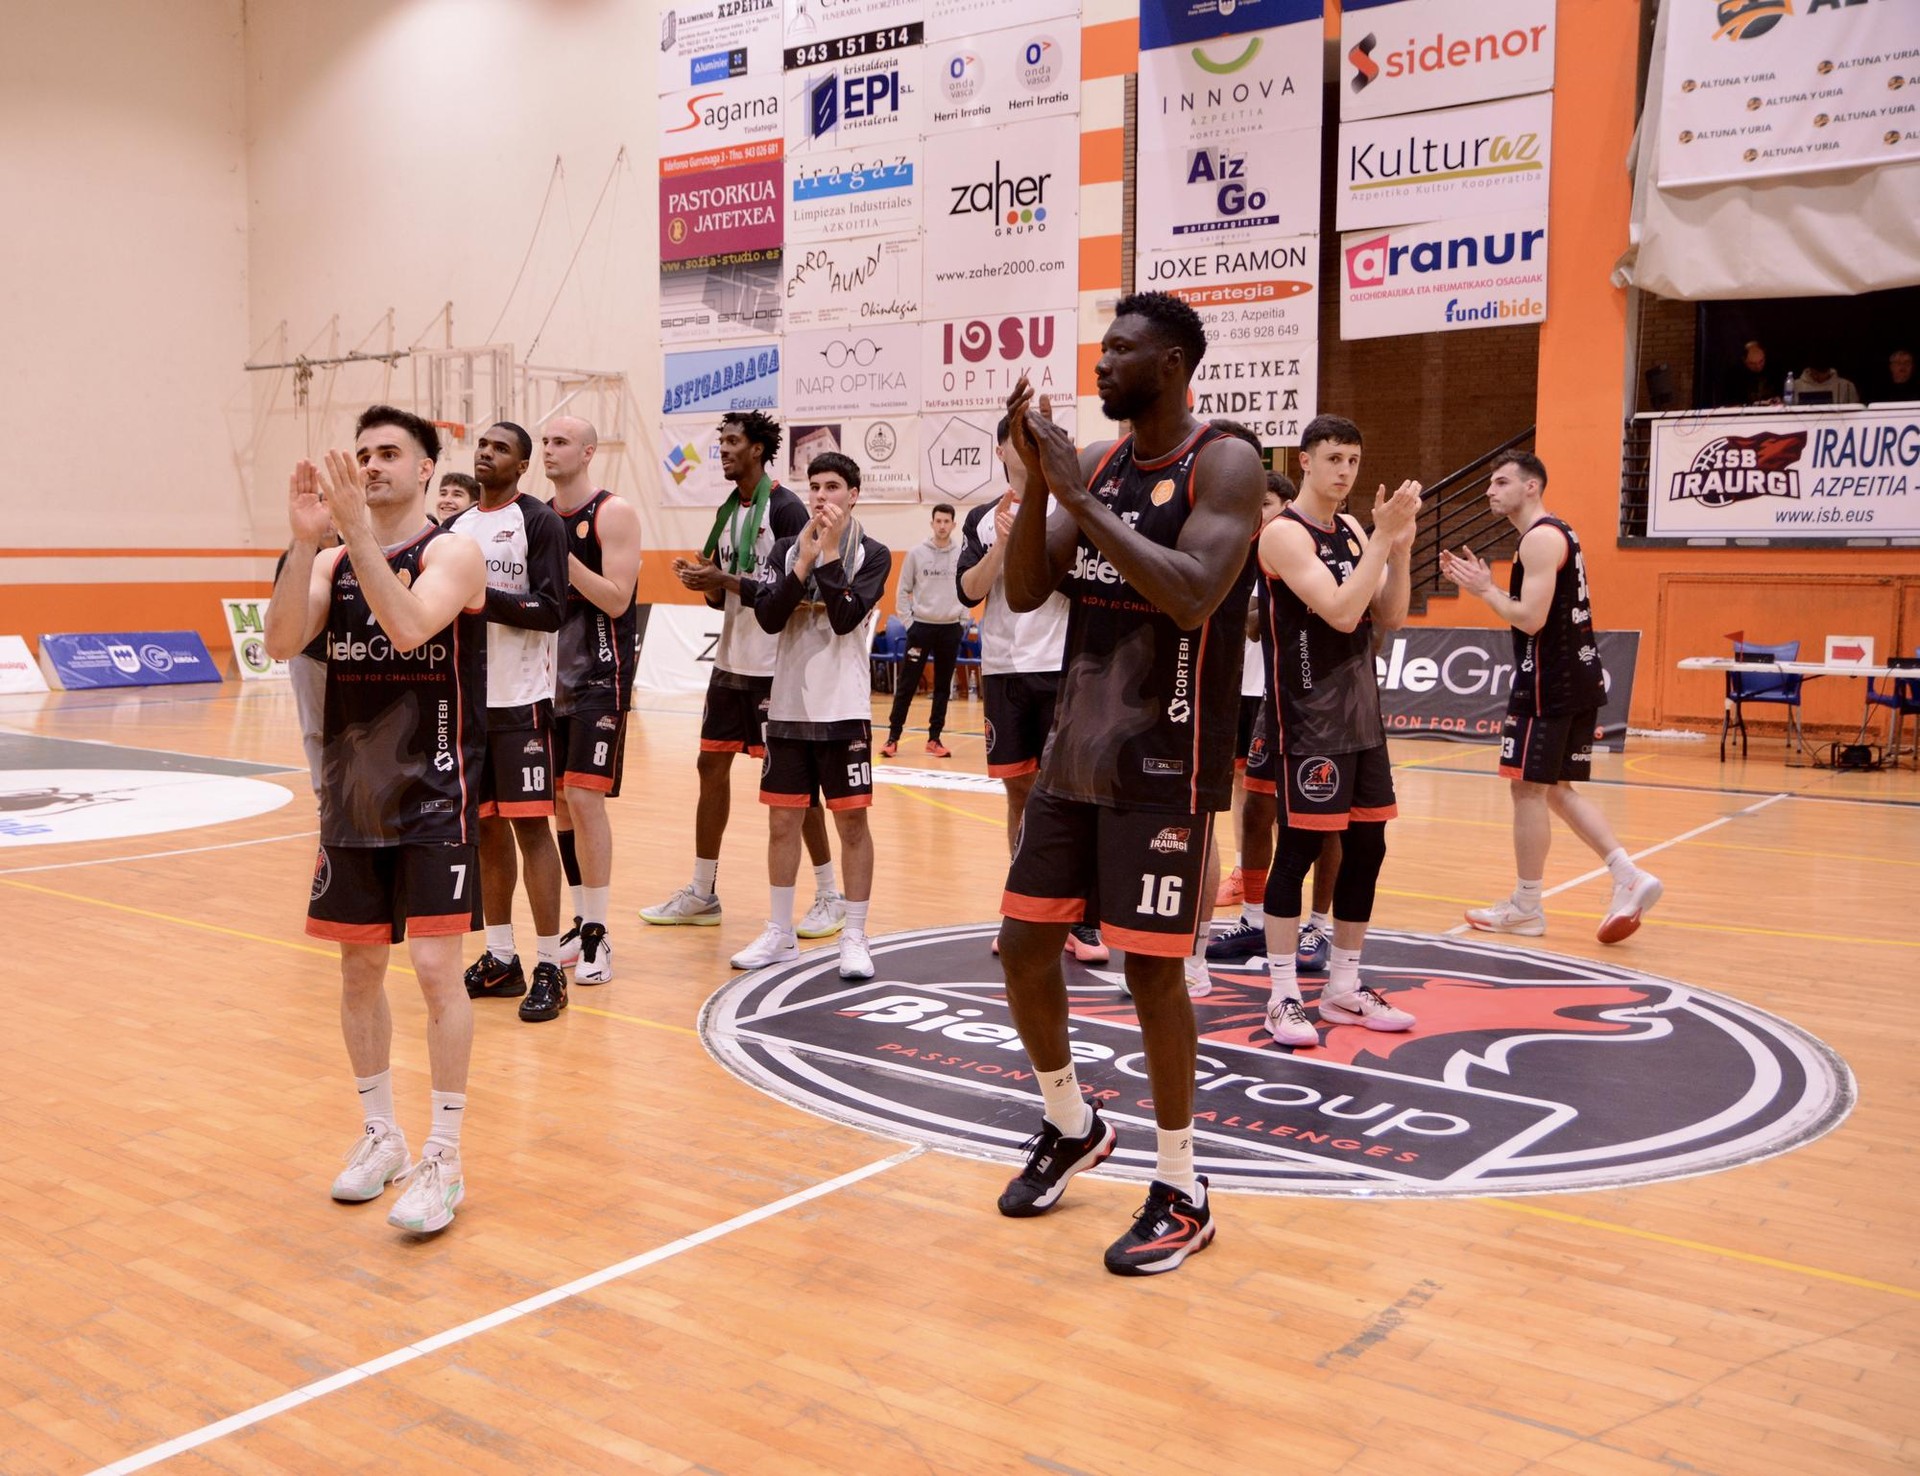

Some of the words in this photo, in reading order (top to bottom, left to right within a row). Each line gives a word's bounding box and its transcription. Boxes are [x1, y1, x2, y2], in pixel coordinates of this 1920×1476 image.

[797, 44, 828, 65] 943
[837, 36, 865, 57] 151
[876, 27, 909, 49] 514
[1385, 24, 1547, 77] sidenor
[844, 57, 898, 76] kristaldegia
[1838, 55, 1881, 70] ALTUNA
[1884, 54, 1891, 62] Y
[1893, 48, 1920, 61] URIA
[1025, 65, 1051, 77] onda
[1027, 75, 1051, 86] vasca
[1700, 77, 1741, 89] ALTUNA
[1743, 75, 1750, 84] Y
[1751, 72, 1776, 83] URIA
[844, 71, 899, 119] EPI
[949, 78, 974, 90] onda
[951, 88, 974, 99] vasca
[1163, 76, 1295, 114] INNOVA
[1009, 98, 1034, 110] Herri
[1037, 91, 1069, 105] Irratia
[1765, 94, 1807, 107] ALTUNA
[1809, 92, 1817, 101] Y
[1818, 88, 1844, 99] URIA
[665, 92, 778, 133] Sagarna
[934, 110, 958, 122] Herri
[961, 104, 991, 118] Irratia
[1191, 108, 1264, 126] AZPEITIA
[1833, 110, 1876, 123] ALTUNA
[1880, 108, 1887, 117] Y
[1889, 104, 1916, 115] URIA
[1190, 130, 1220, 140] HORTZ
[1225, 124, 1263, 135] KLINIKA
[1697, 128, 1737, 140] ALTUNA
[1739, 127, 1746, 135] Y
[1747, 123, 1772, 134] URIA
[1351, 133, 1541, 181] Kulturaz
[1762, 145, 1803, 158] ALTUNA
[1806, 144, 1812, 153] Y
[1814, 141, 1840, 151] URIA
[799, 155, 908, 190] iragaz
[1187, 150, 1245, 184] Aiz
[668, 180, 776, 214] PASTORKUA
[949, 160, 1052, 226] zaher
[1352, 187, 1409, 201] Azpeitiko
[1416, 182, 1455, 194] Kultur
[1462, 172, 1541, 189] Kooperatiba
[794, 206, 846, 222] Limpiezas
[850, 196, 912, 214] Industriales
[1217, 183, 1266, 216] Go
[694, 205, 776, 233] JATETXEA
[822, 218, 879, 233] AZKOITIA
[995, 223, 1046, 237] GRUPO
[660, 249, 780, 272] www.sofia-studio.es
[1148, 256, 1207, 281] JOXE
[1216, 246, 1306, 274] RAMON
[1353, 228, 1544, 281] aranur
[936, 259, 1065, 281] www.zaher2000.com
[1350, 287, 1415, 302] OLEOHIDRAULIKA
[1417, 286, 1430, 295] ETA
[1432, 278, 1494, 293] NEUMATIKAKO
[1495, 274, 1543, 286] OSAGAIAK
[718, 308, 783, 323] STUDIO
[861, 299, 918, 320] Okindegia
[1241, 308, 1285, 321] Azpeitia
[1445, 297, 1543, 322] fundibide
[943, 316, 1055, 365] IOSU
[1230, 328, 1250, 340] 636
[1254, 326, 1274, 338] 928
[1278, 324, 1299, 336] 649
[662, 349, 780, 414] ASTIGARRAGA
[943, 366, 1053, 392] OPTIKA
[1198, 359, 1300, 381] JATETXEA
[796, 376, 835, 395] INAR
[840, 371, 907, 393] OPTIKA
[730, 398, 775, 409] Edariak
[950, 399, 963, 407] 943
[1049, 393, 1073, 401] PEITIA
[941, 447, 981, 466] LATZ
[1713, 449, 1757, 469] ISB
[1670, 469, 1799, 500] IRAURGI
[1811, 476, 1907, 498] AZPEITIA
[1775, 506, 1874, 524] www.isb.eus
[1175, 637, 1190, 697] CORTEBI
[1299, 629, 1312, 689] DECO-RAMIK
[385, 673, 447, 681] CHALLENGES
[438, 699, 448, 750] CORTEBI
[1429, 716, 1467, 731] FOR
[593, 741, 609, 767] 8
[521, 765, 545, 792] 18
[847, 761, 871, 787] 50
[1150, 839, 1188, 851] IRAURGI
[450, 864, 466, 900] 7
[1136, 873, 1183, 917] 16
[876, 1043, 1034, 1081] PASSION
[1077, 1083, 1121, 1100] OR
[1136, 1098, 1420, 1163] CALLENGES
